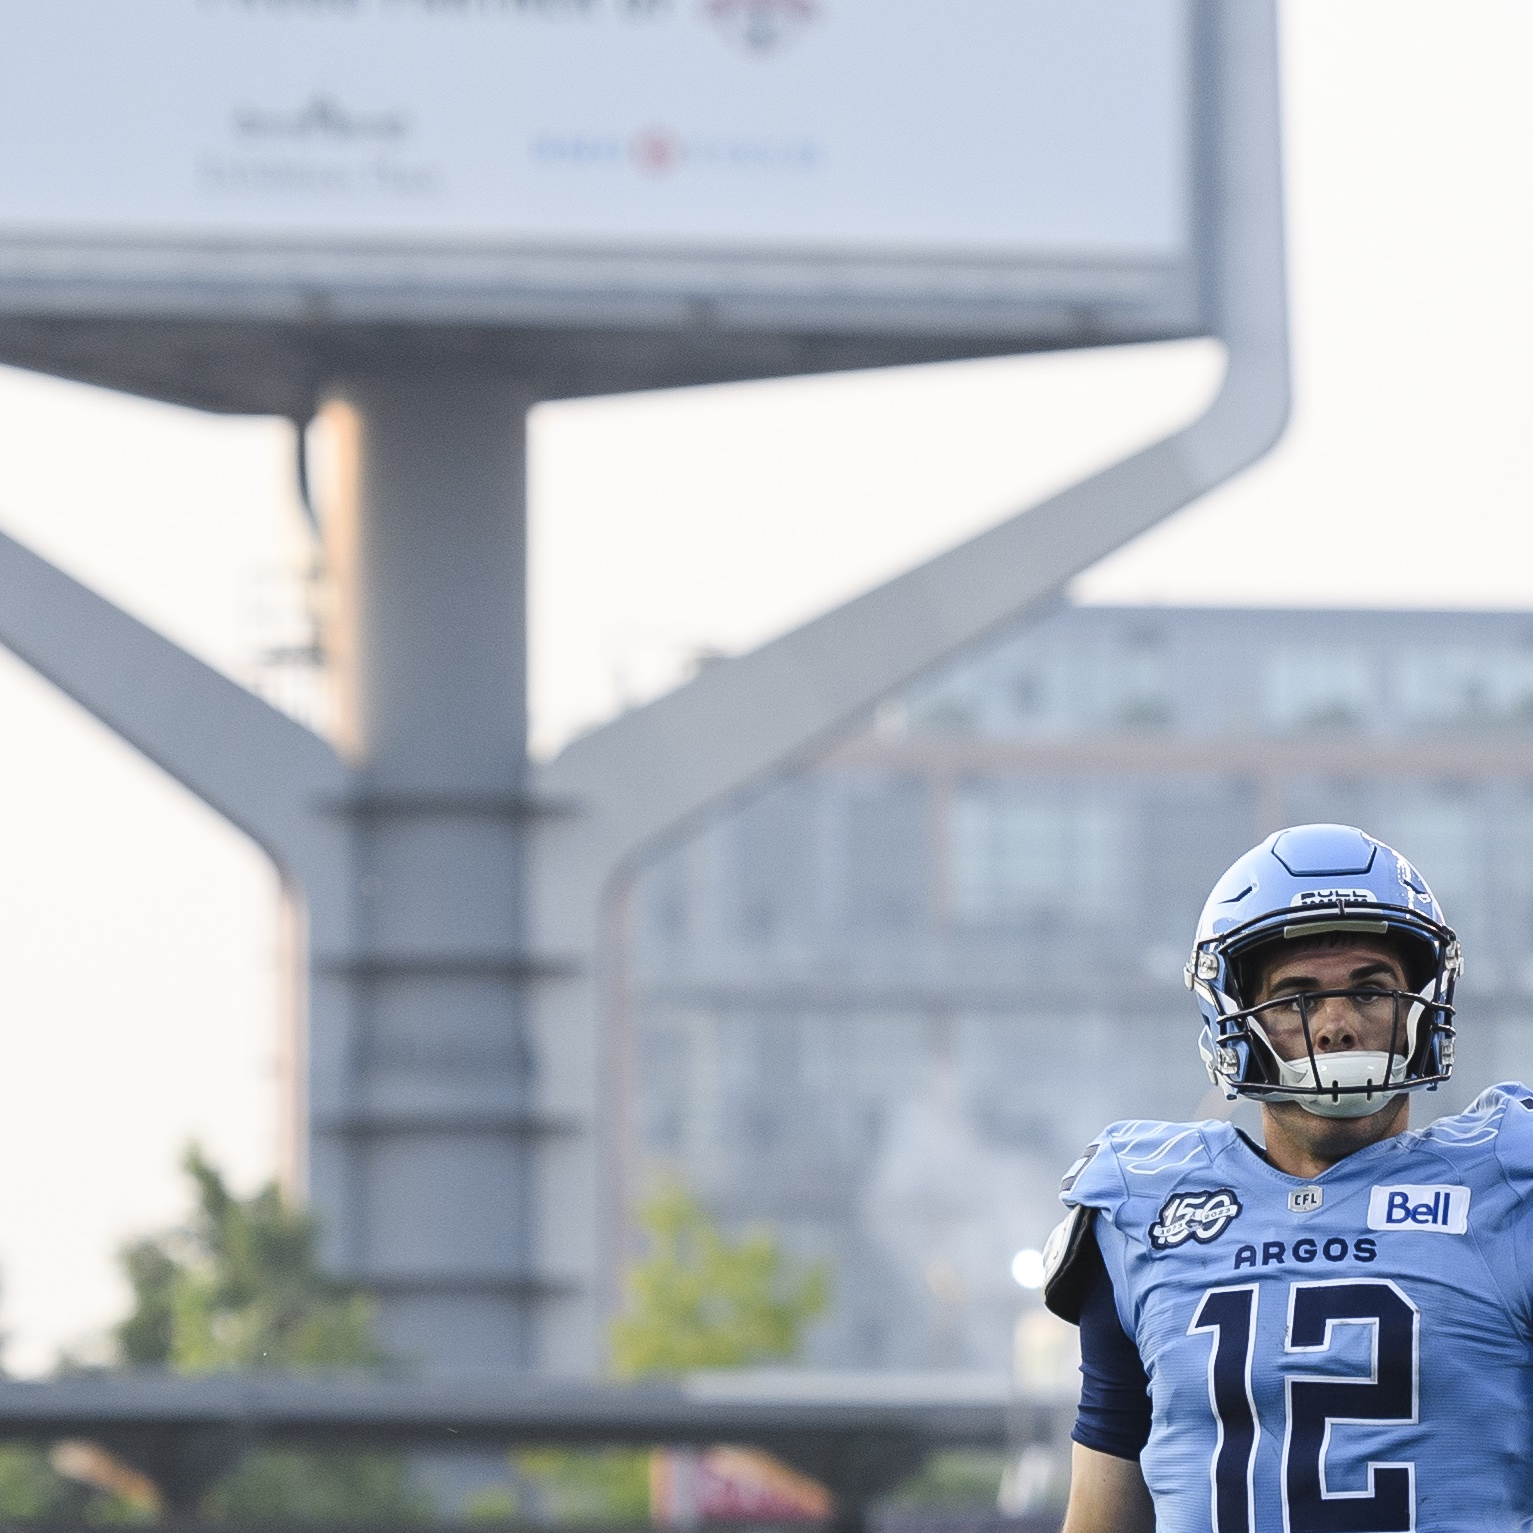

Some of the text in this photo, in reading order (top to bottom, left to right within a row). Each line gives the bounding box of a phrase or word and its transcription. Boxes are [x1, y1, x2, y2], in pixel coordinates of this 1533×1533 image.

[1294, 1192, 1317, 1206] CFL
[1385, 1191, 1450, 1226] Bell
[1234, 1237, 1378, 1271] ARGOS
